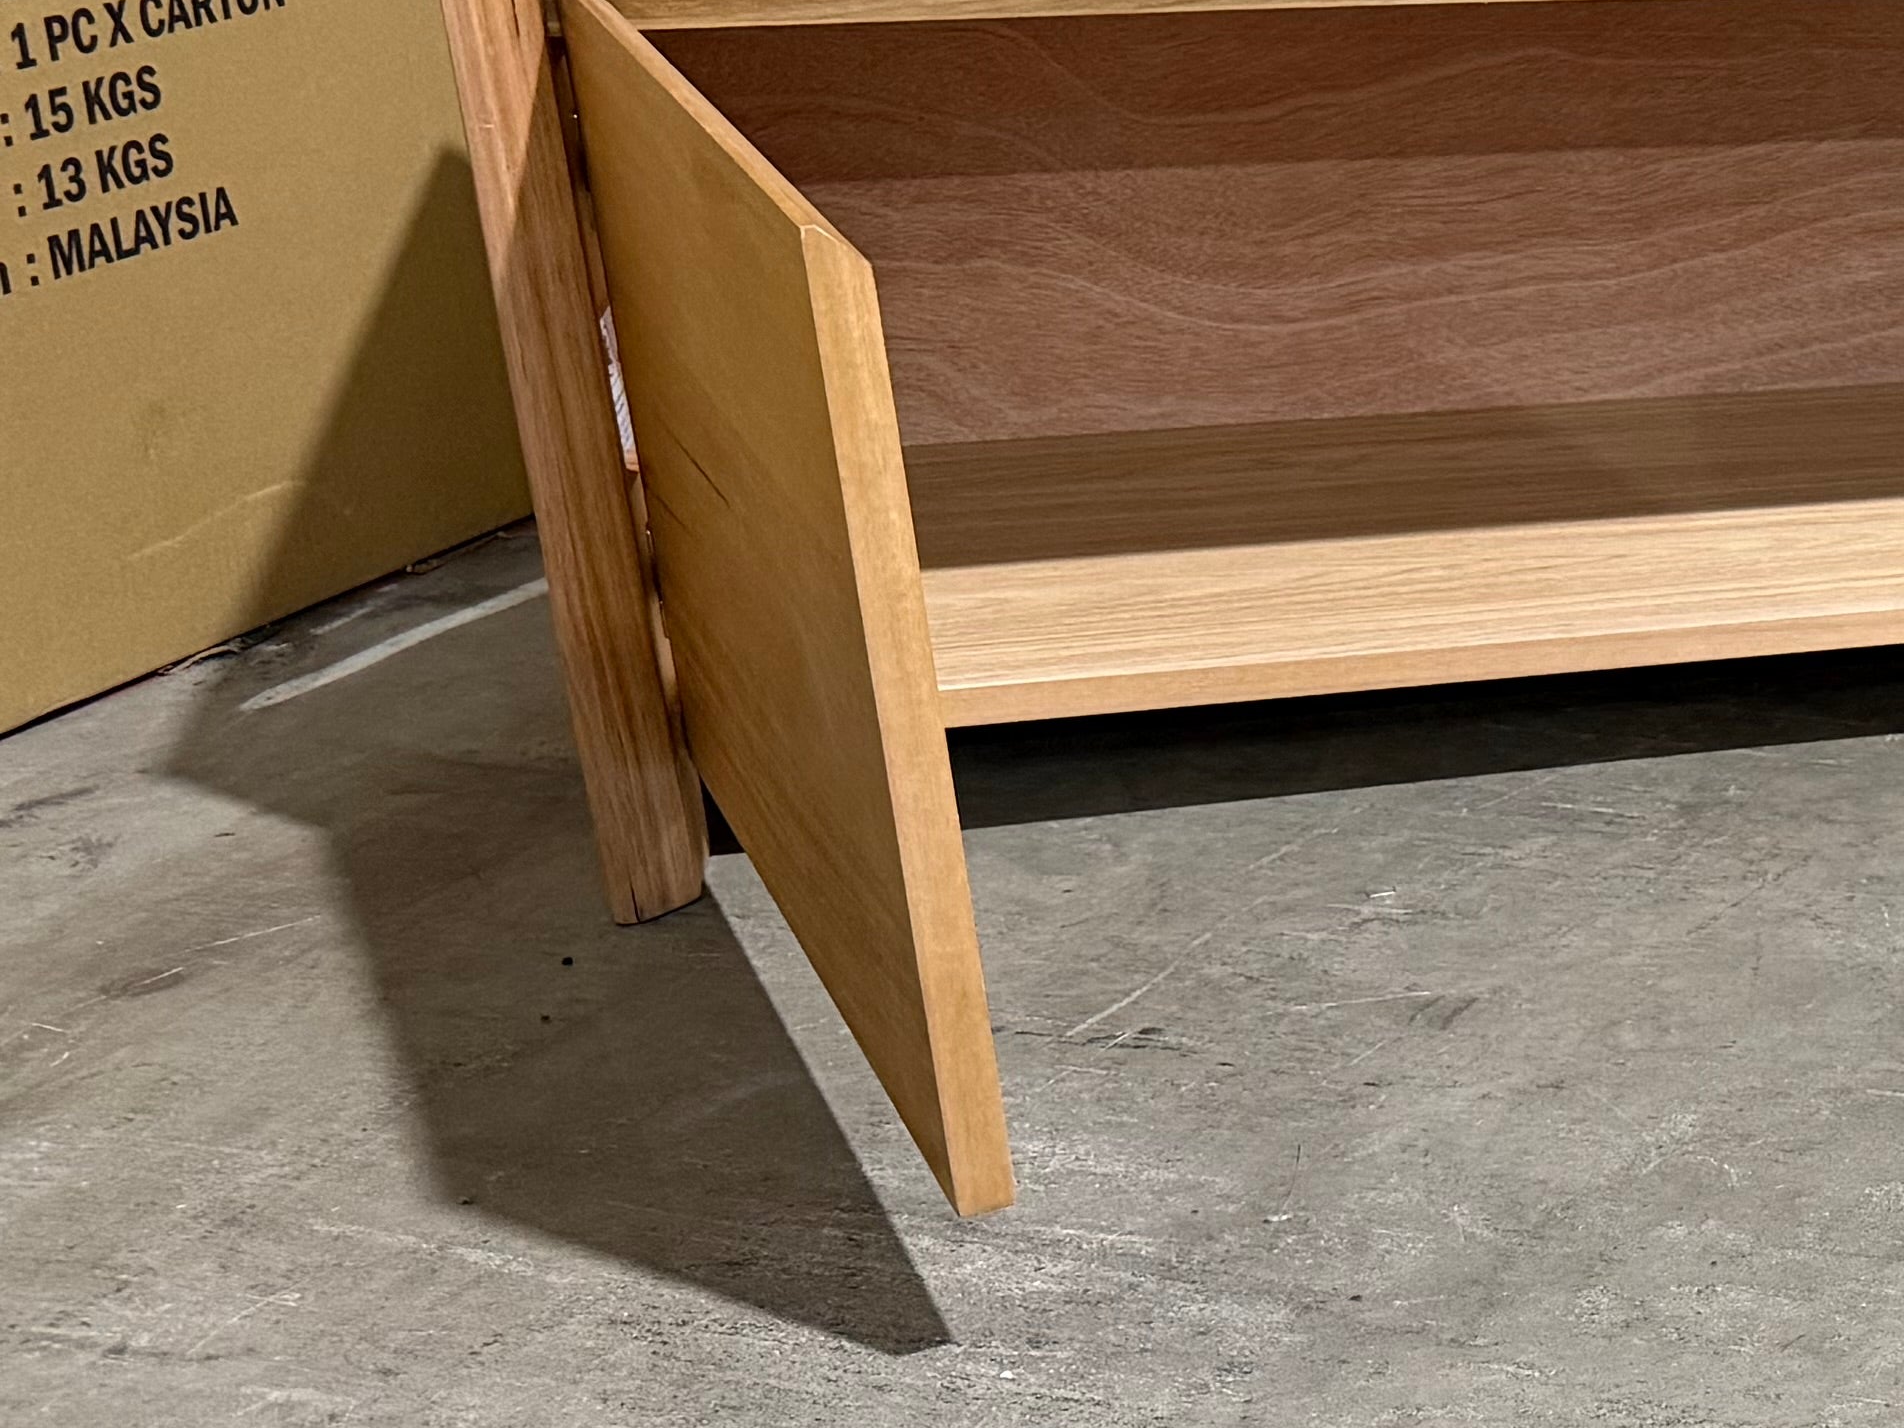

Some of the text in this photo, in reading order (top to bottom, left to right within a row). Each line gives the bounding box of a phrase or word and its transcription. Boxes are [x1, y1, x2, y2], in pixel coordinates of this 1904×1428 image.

[11, 23, 37, 69] 1
[44, 8, 98, 62] PC
[103, 0, 134, 48] X
[24, 86, 74, 141] 15
[82, 65, 161, 125] KGS
[37, 157, 86, 210] 13
[95, 133, 173, 194] KGS
[47, 187, 239, 280] MALAYSIA
